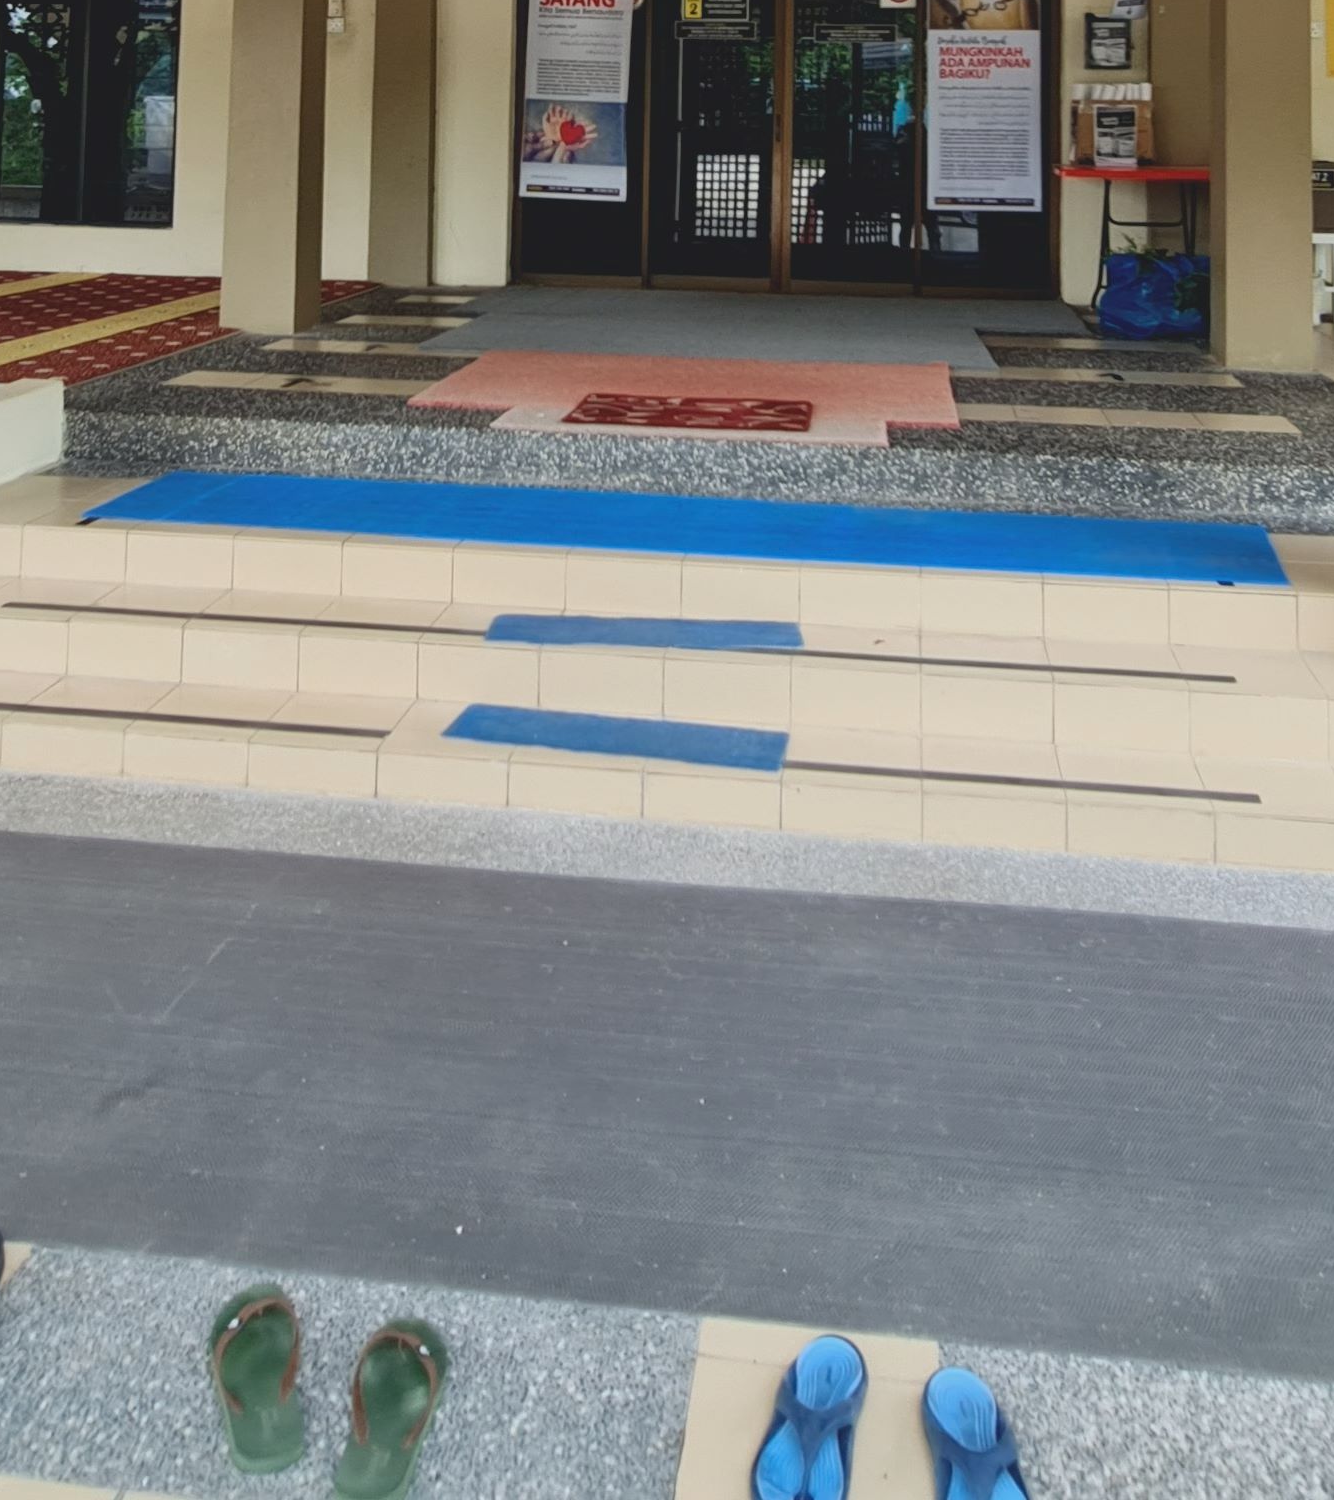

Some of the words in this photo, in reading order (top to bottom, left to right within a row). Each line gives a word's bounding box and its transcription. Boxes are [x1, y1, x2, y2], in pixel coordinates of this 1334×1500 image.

[689, 3, 698, 15] 2
[939, 47, 1024, 57] MUNGKINKAH
[939, 58, 964, 68] ADA
[968, 58, 1031, 68] AMPUNAN
[939, 68, 990, 79] BAGIKU?
